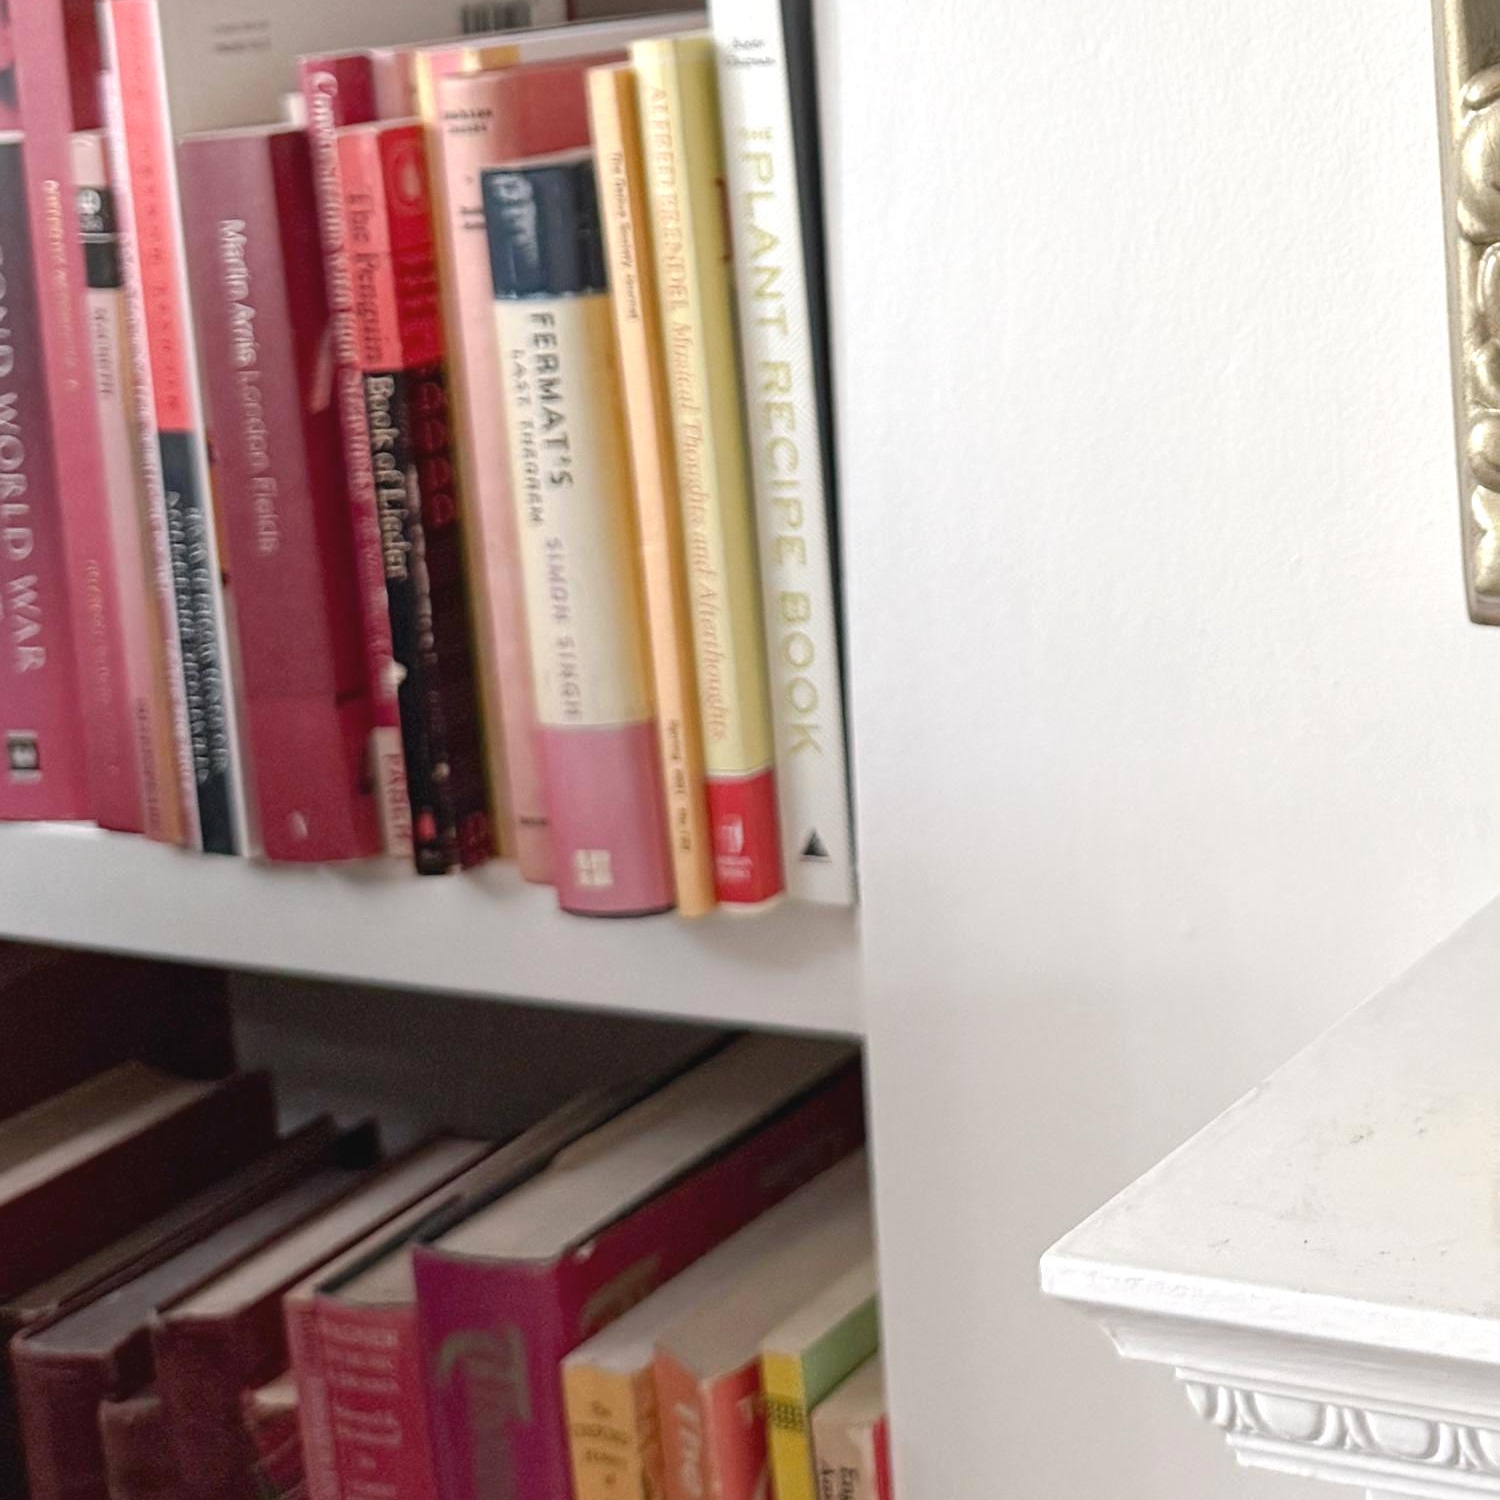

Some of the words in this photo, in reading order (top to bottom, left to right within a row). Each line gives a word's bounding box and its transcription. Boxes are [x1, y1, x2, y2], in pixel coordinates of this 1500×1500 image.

[744, 151, 789, 339] PLANT
[226, 302, 258, 366] Amis
[252, 477, 281, 557] Fields
[364, 374, 396, 450] Book
[529, 311, 573, 488] FERMAT'S
[762, 360, 807, 566] RECIPE
[374, 453, 405, 486] of
[8, 573, 47, 669] WAR
[545, 538, 569, 622] SIMON
[555, 636, 581, 722] SINGH
[778, 591, 821, 757] BOOK
